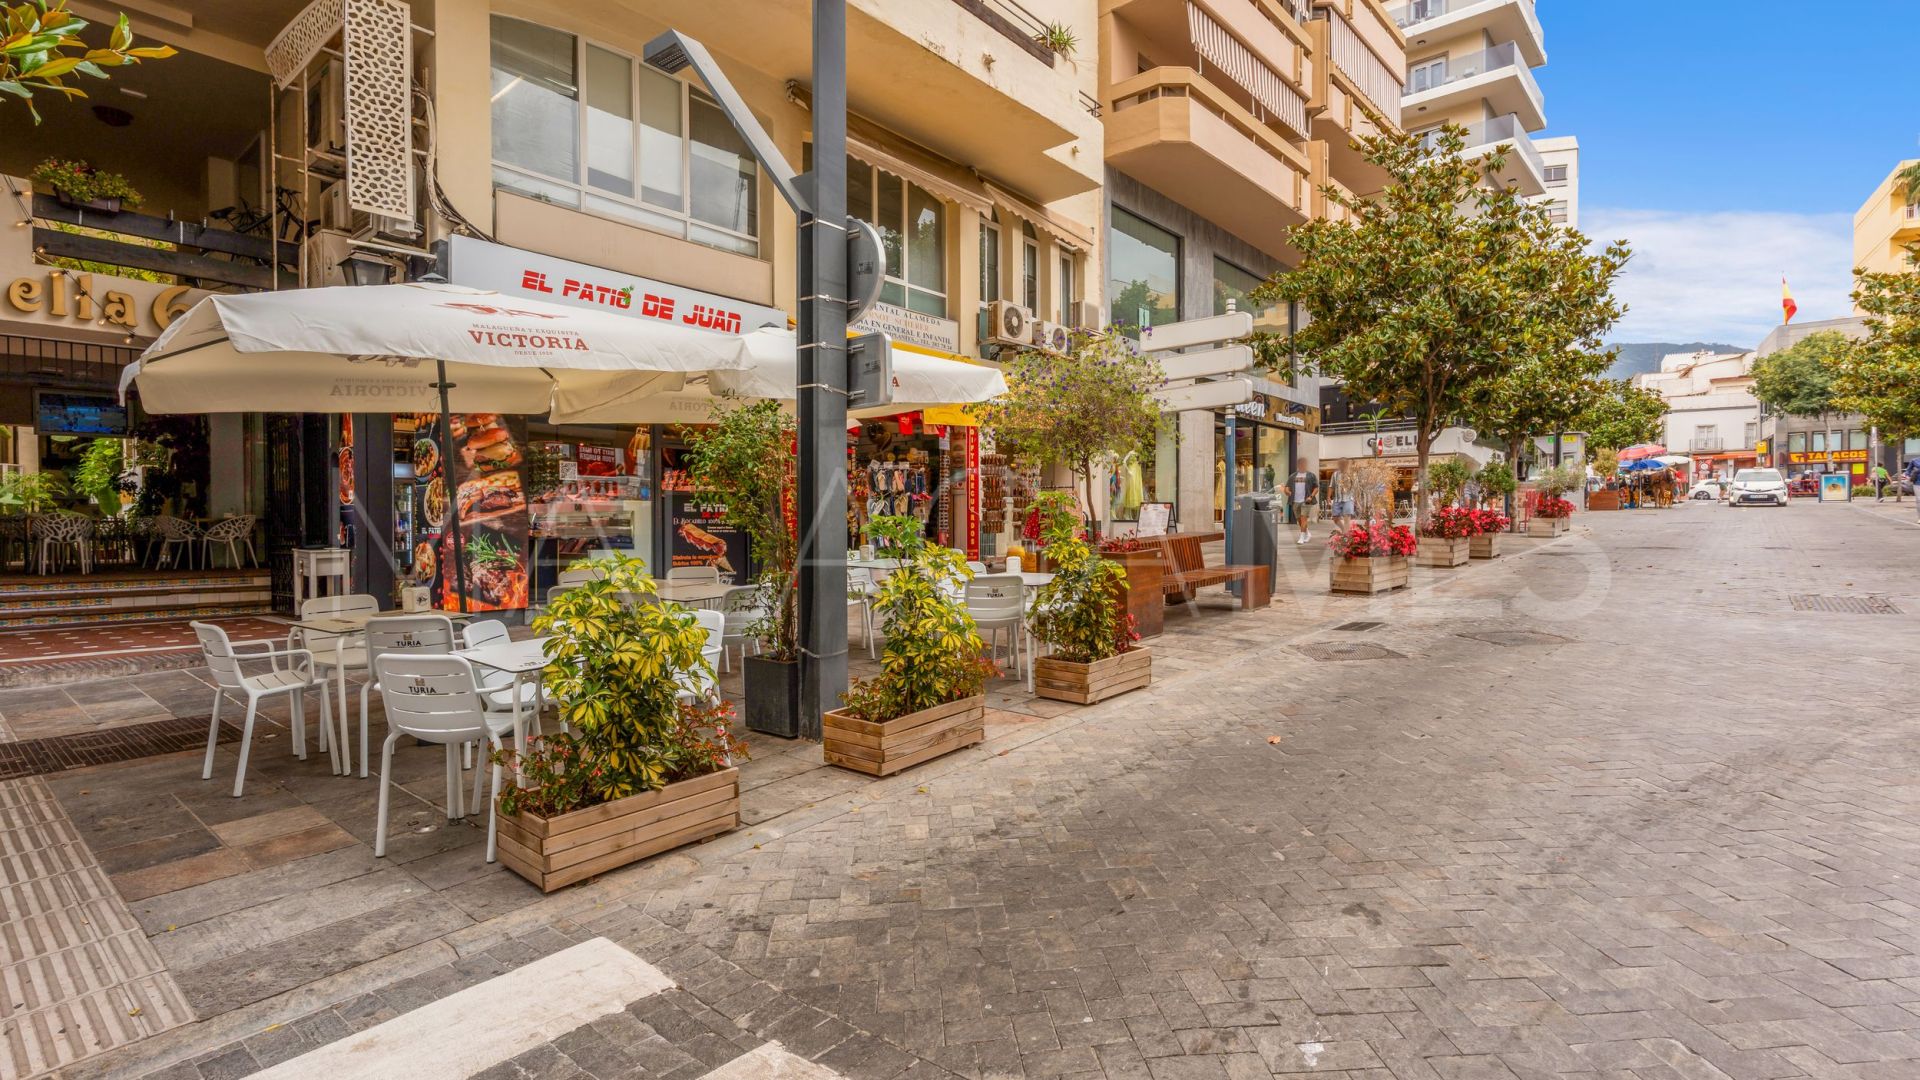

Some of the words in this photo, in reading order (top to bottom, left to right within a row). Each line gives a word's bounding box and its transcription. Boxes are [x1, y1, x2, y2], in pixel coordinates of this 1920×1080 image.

[521, 269, 553, 294] EL
[563, 278, 632, 309] PATIO
[642, 293, 675, 321] DE
[682, 304, 742, 334] JUAN
[467, 330, 590, 351] VICTORIA
[1807, 451, 1867, 459] TAACOS
[683, 503, 697, 512] EL
[408, 686, 437, 694] TURIA
